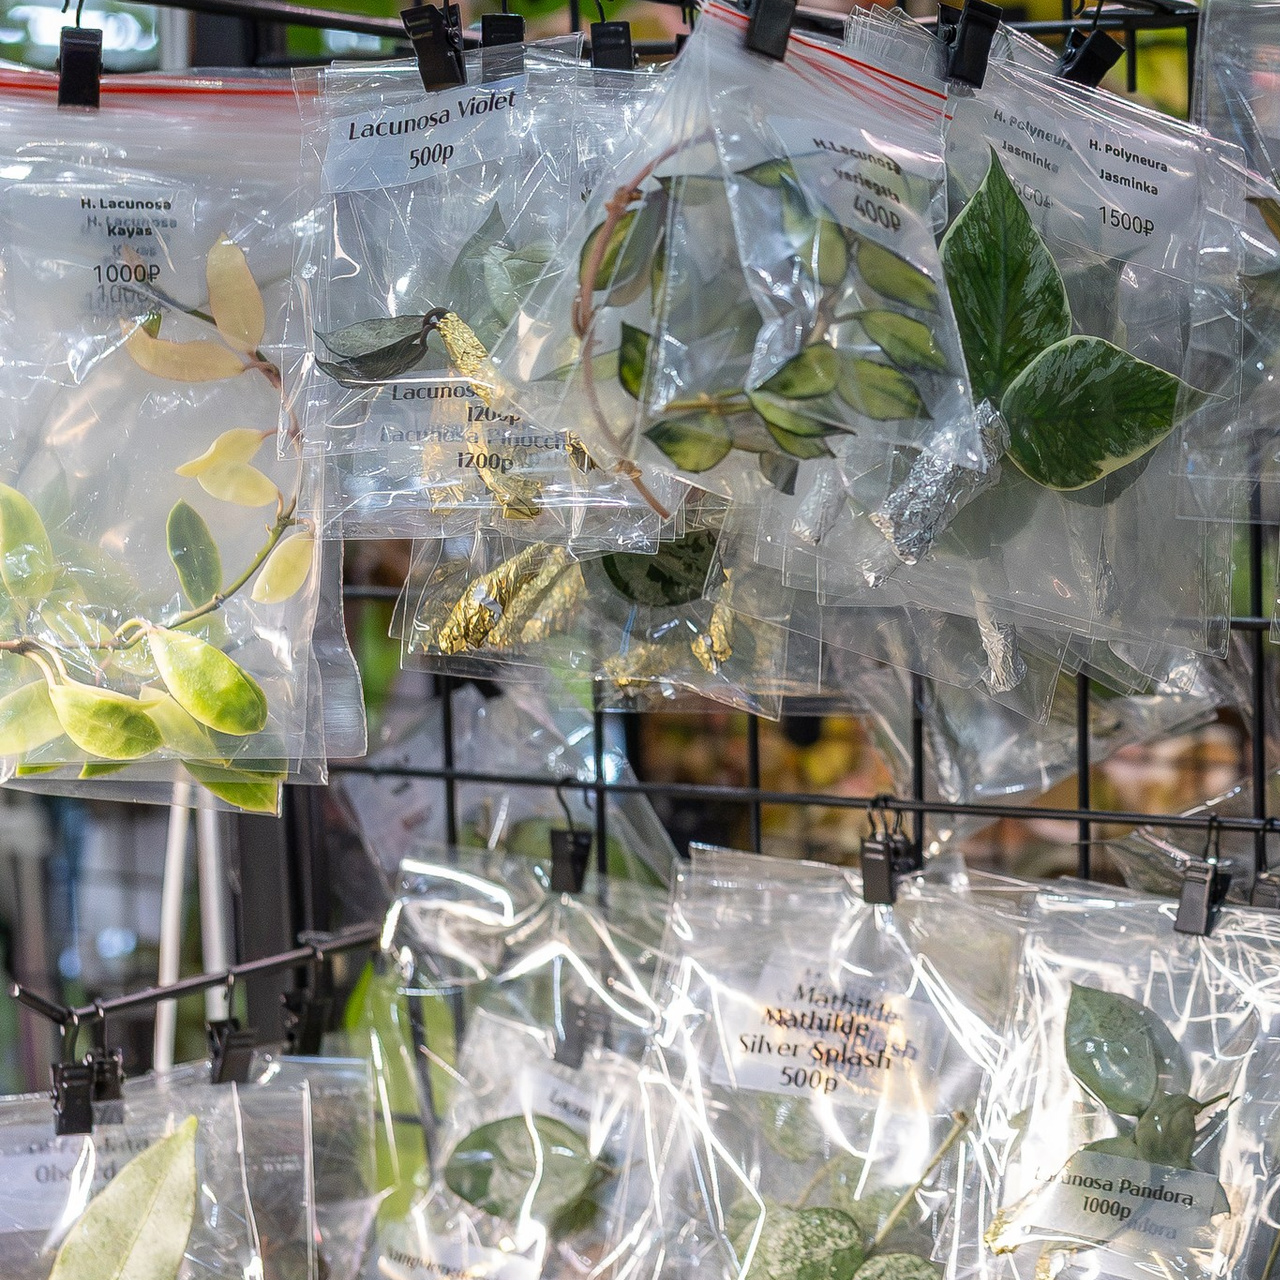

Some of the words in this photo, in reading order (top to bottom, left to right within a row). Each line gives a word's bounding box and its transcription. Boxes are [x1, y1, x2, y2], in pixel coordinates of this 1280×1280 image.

[348, 108, 450, 141] Lacunosa
[457, 91, 517, 119] Violet
[409, 143, 454, 170] 500p
[1089, 138, 1102, 152] H.
[1105, 143, 1168, 173] Polyneura
[1099, 168, 1159, 196] Jasminka
[81, 198, 96, 209] H.
[100, 198, 172, 210] Lacunosa
[107, 225, 153, 239] Kayas
[1099, 206, 1155, 237] 1500₽
[93, 264, 161, 284] 1000₽
[391, 384, 480, 401] Lacunos
[457, 451, 514, 474] 1200p
[739, 1033, 804, 1057] Silver
[810, 1041, 892, 1070] Splash
[779, 1066, 839, 1094] 500p
[1119, 1178, 1194, 1207] Pandora
[1083, 1196, 1132, 1221] 1000p
